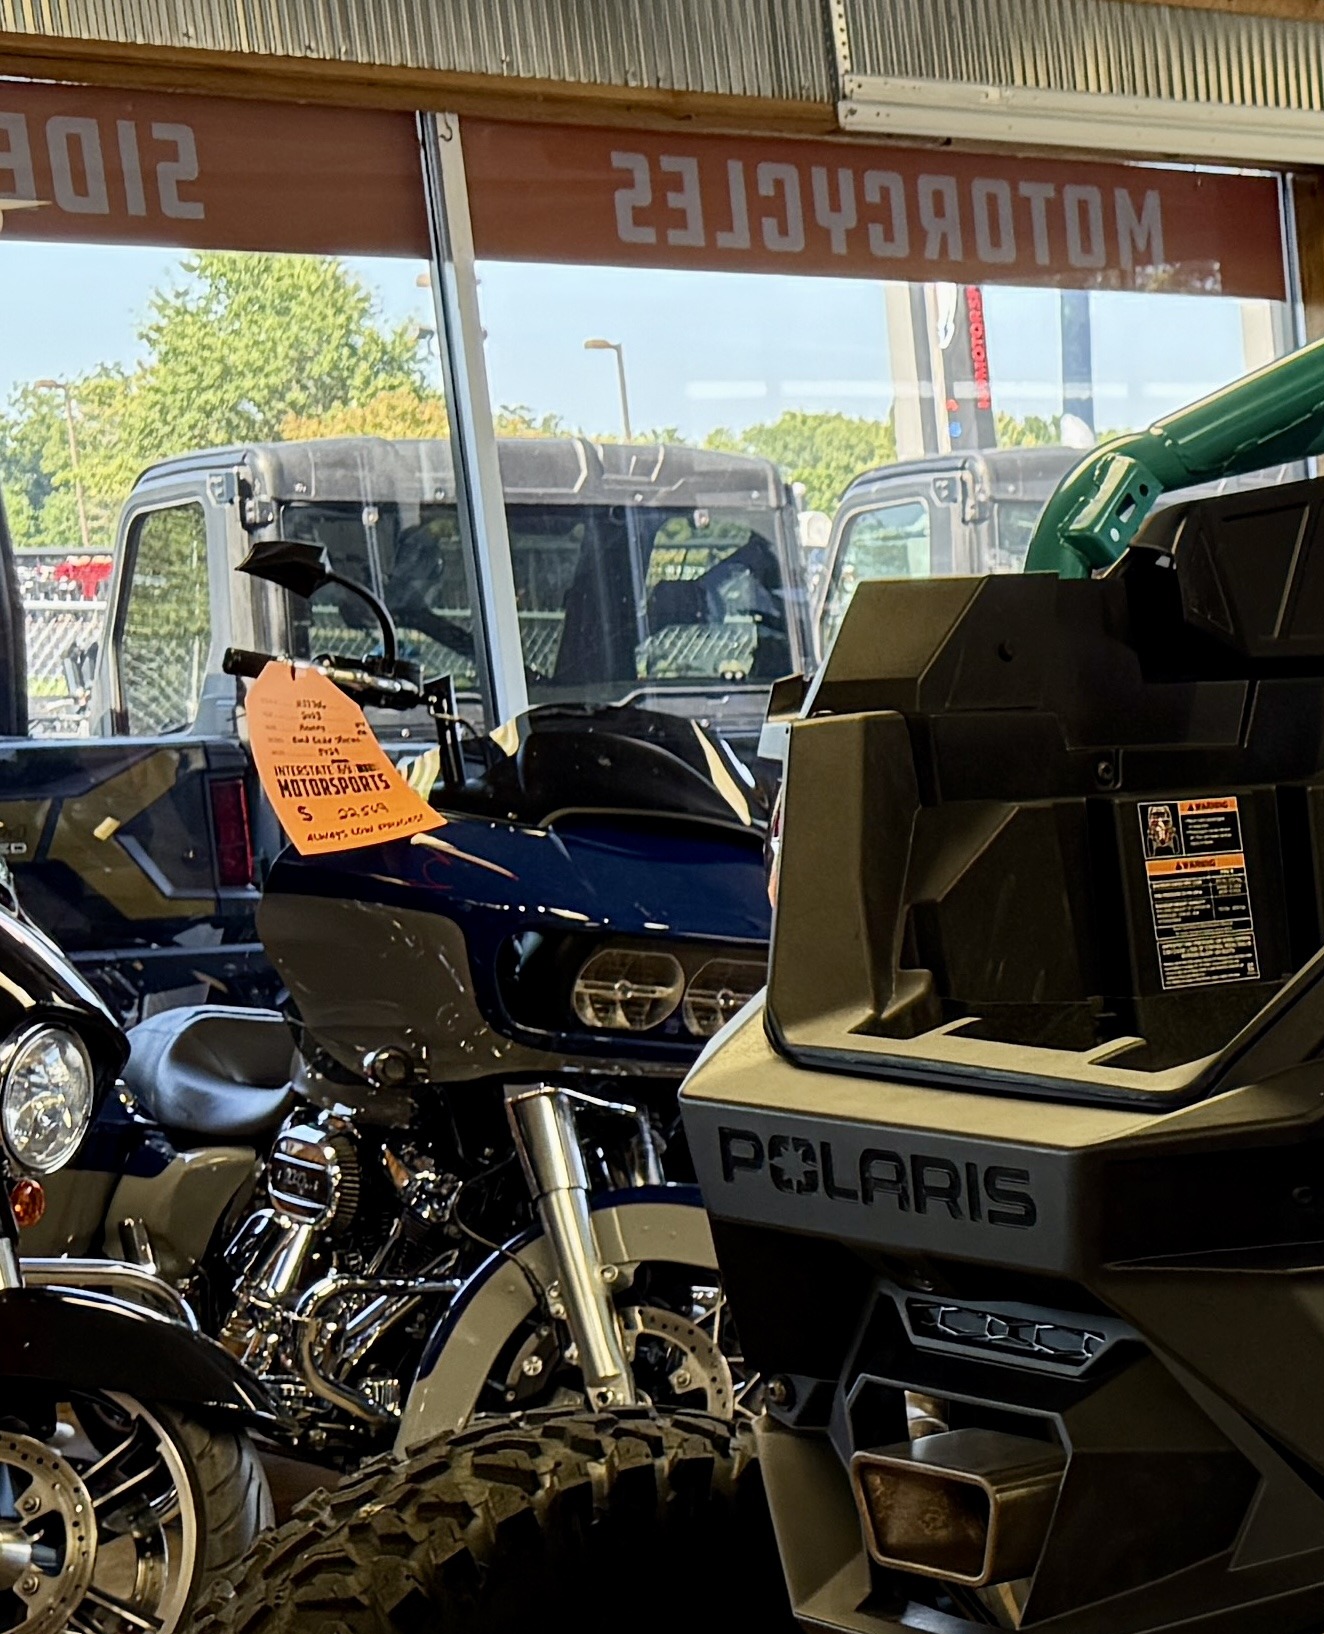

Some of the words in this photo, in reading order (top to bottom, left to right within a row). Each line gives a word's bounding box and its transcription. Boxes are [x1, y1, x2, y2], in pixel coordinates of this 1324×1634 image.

[274, 764, 333, 777] INTERSTATE
[277, 773, 391, 798] MOTORSPORTS
[718, 1126, 1037, 1229] POLARIS
